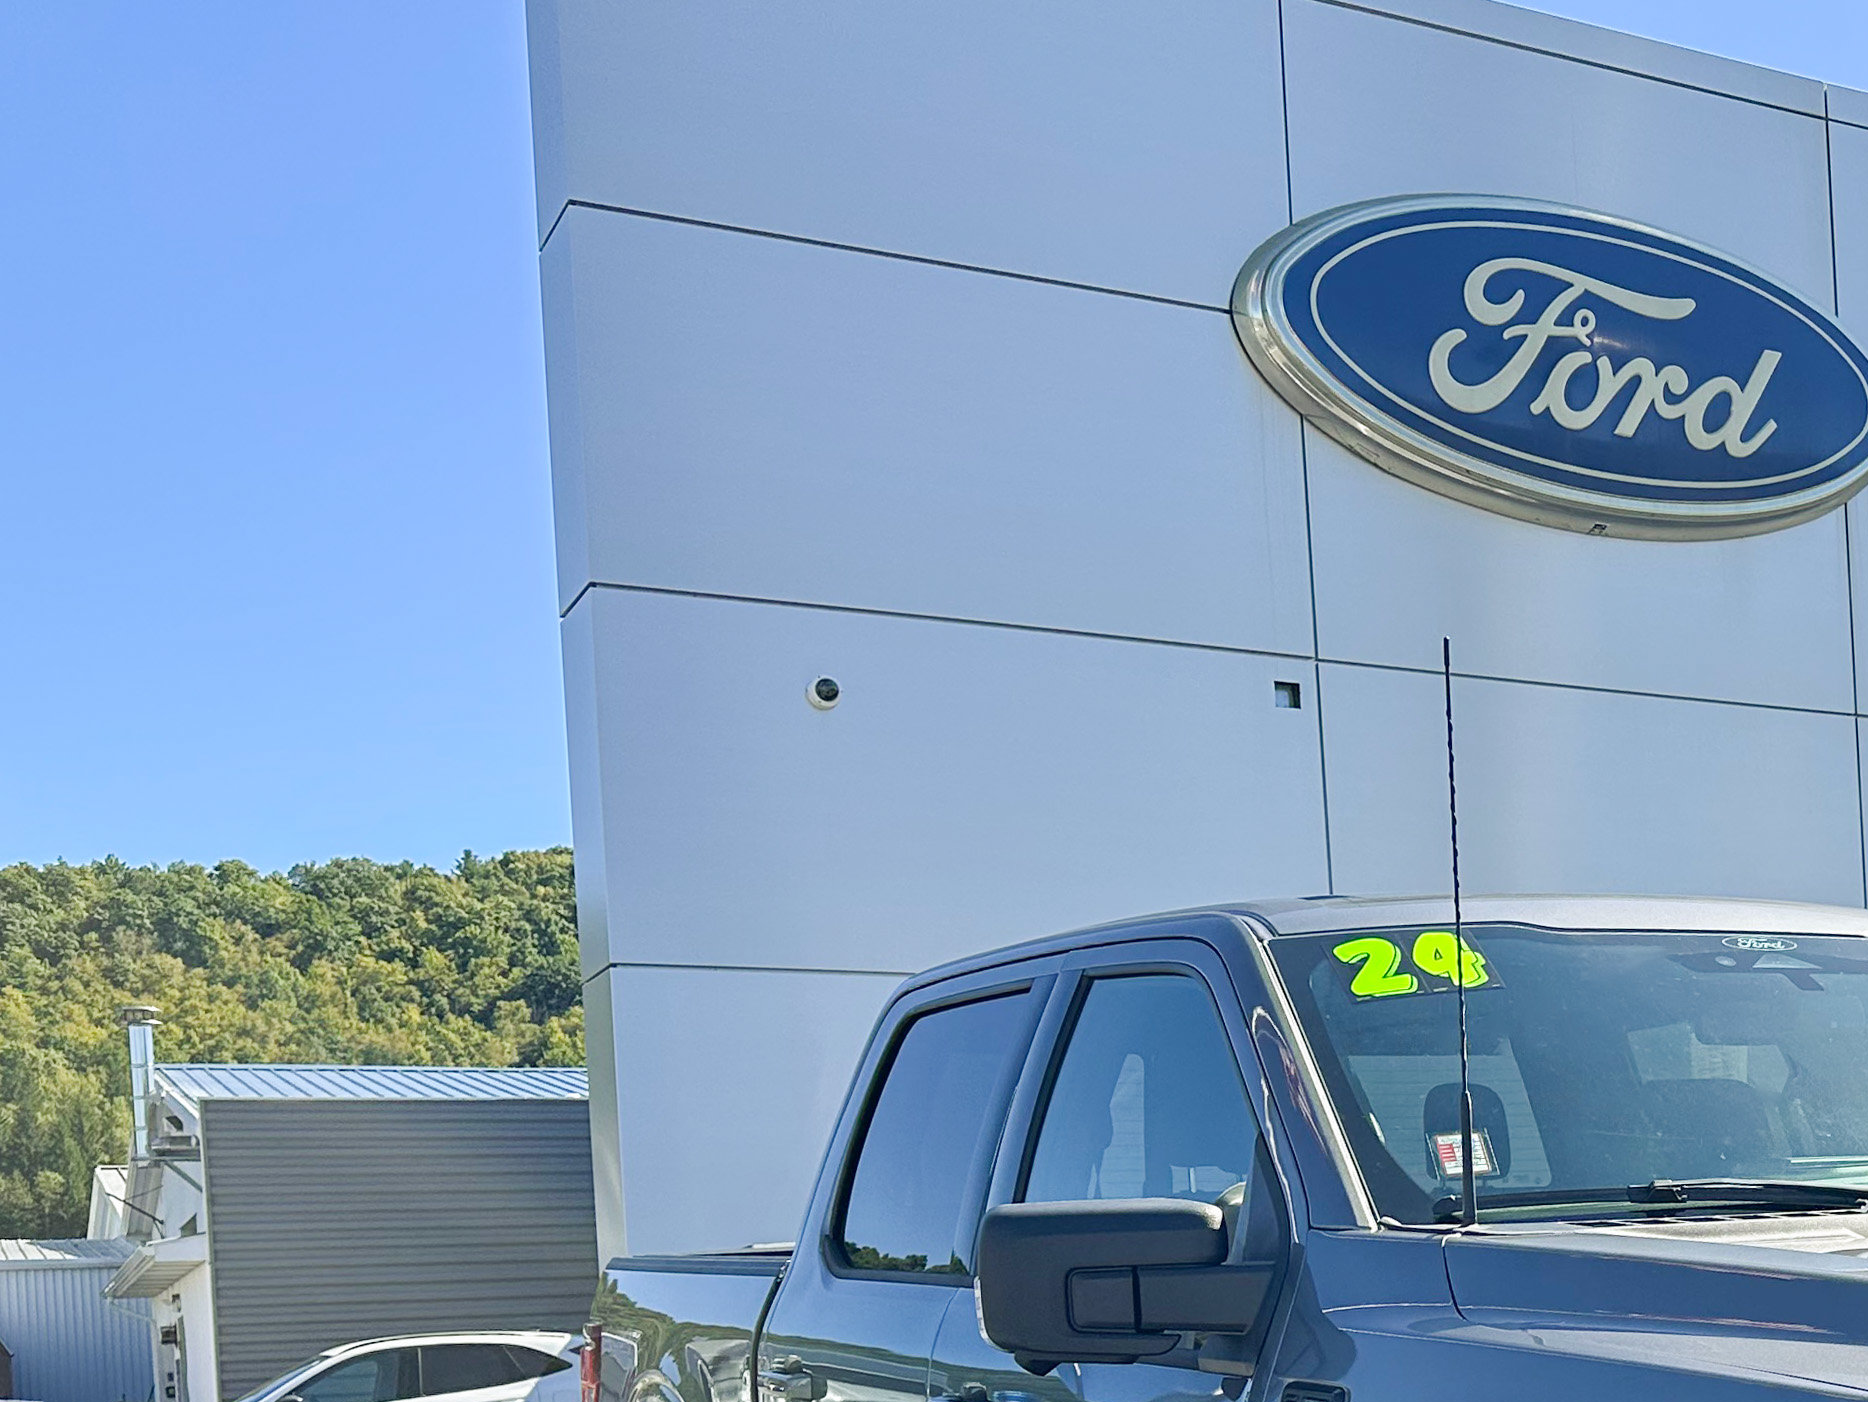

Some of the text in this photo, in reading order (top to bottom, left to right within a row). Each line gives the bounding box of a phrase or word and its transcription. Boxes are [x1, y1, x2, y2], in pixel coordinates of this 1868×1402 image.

[1428, 256, 1783, 458] Ford
[1332, 931, 1490, 997] 24
[1737, 936, 1786, 949] Ford
